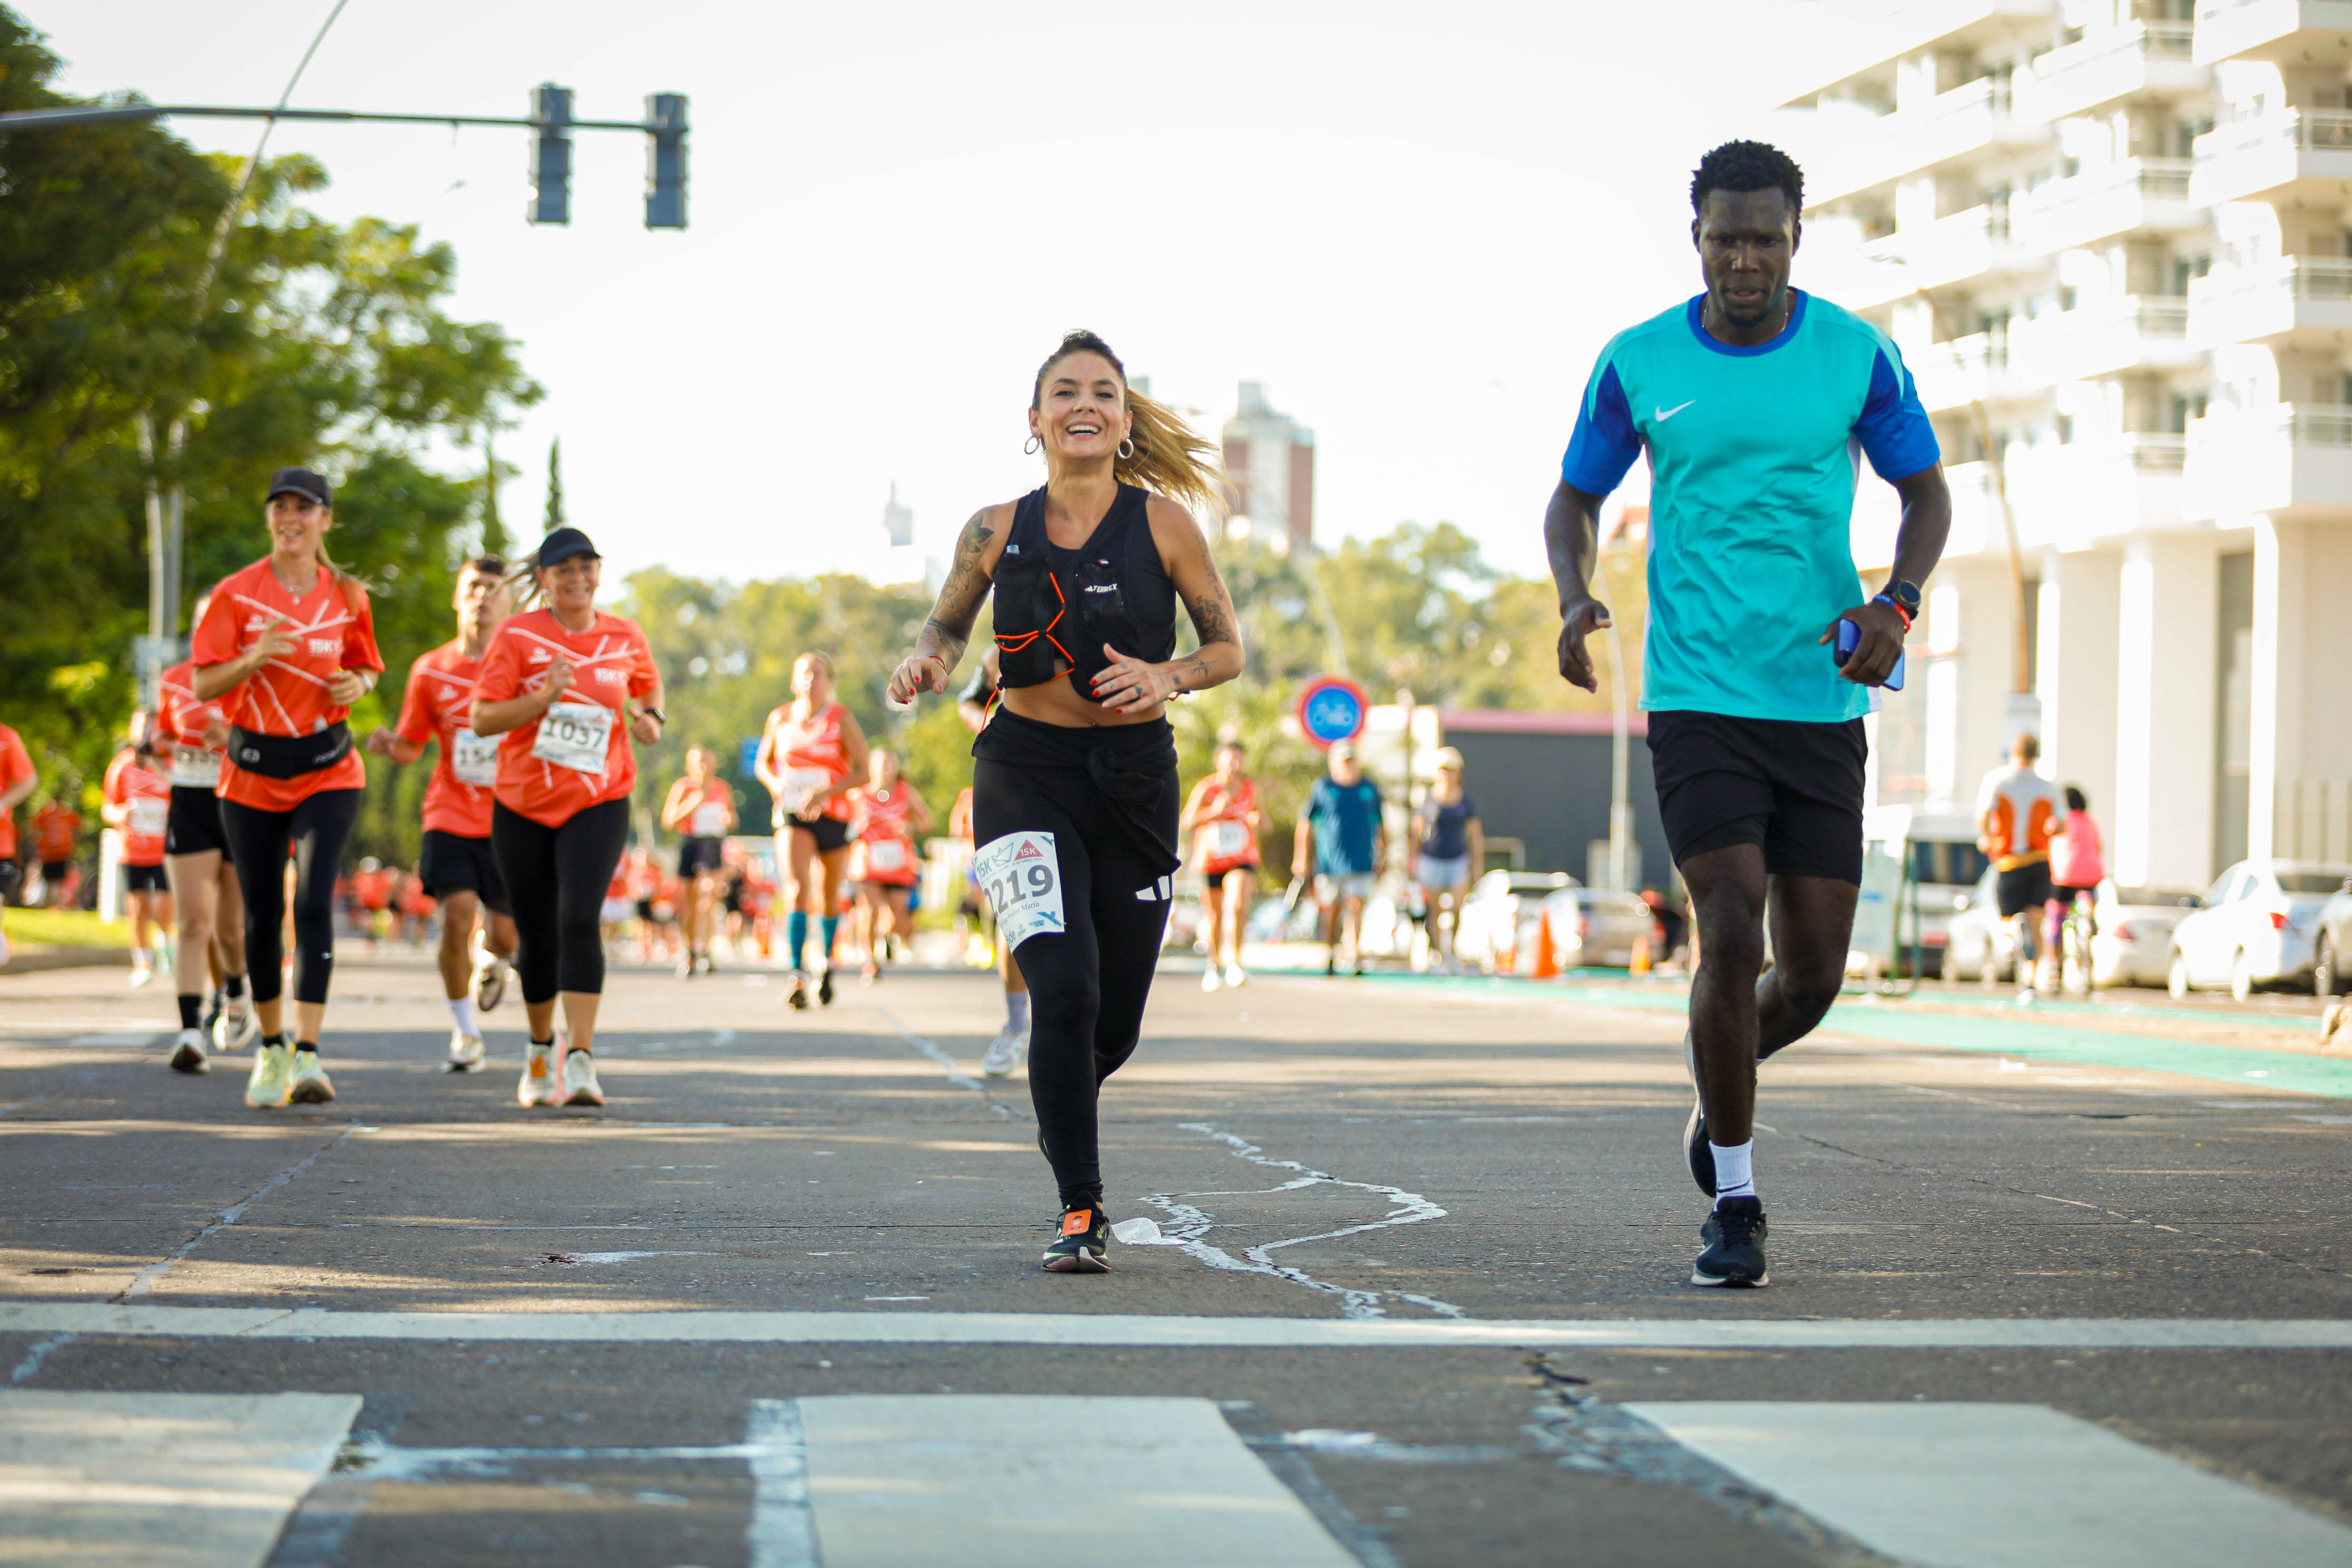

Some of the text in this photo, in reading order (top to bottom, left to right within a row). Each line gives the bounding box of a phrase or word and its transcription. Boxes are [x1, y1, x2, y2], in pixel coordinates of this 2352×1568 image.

[1093, 583, 1117, 593] TERREX
[543, 718, 604, 747] 1037
[1020, 848, 1037, 856] 15K
[977, 857, 992, 879] 15K
